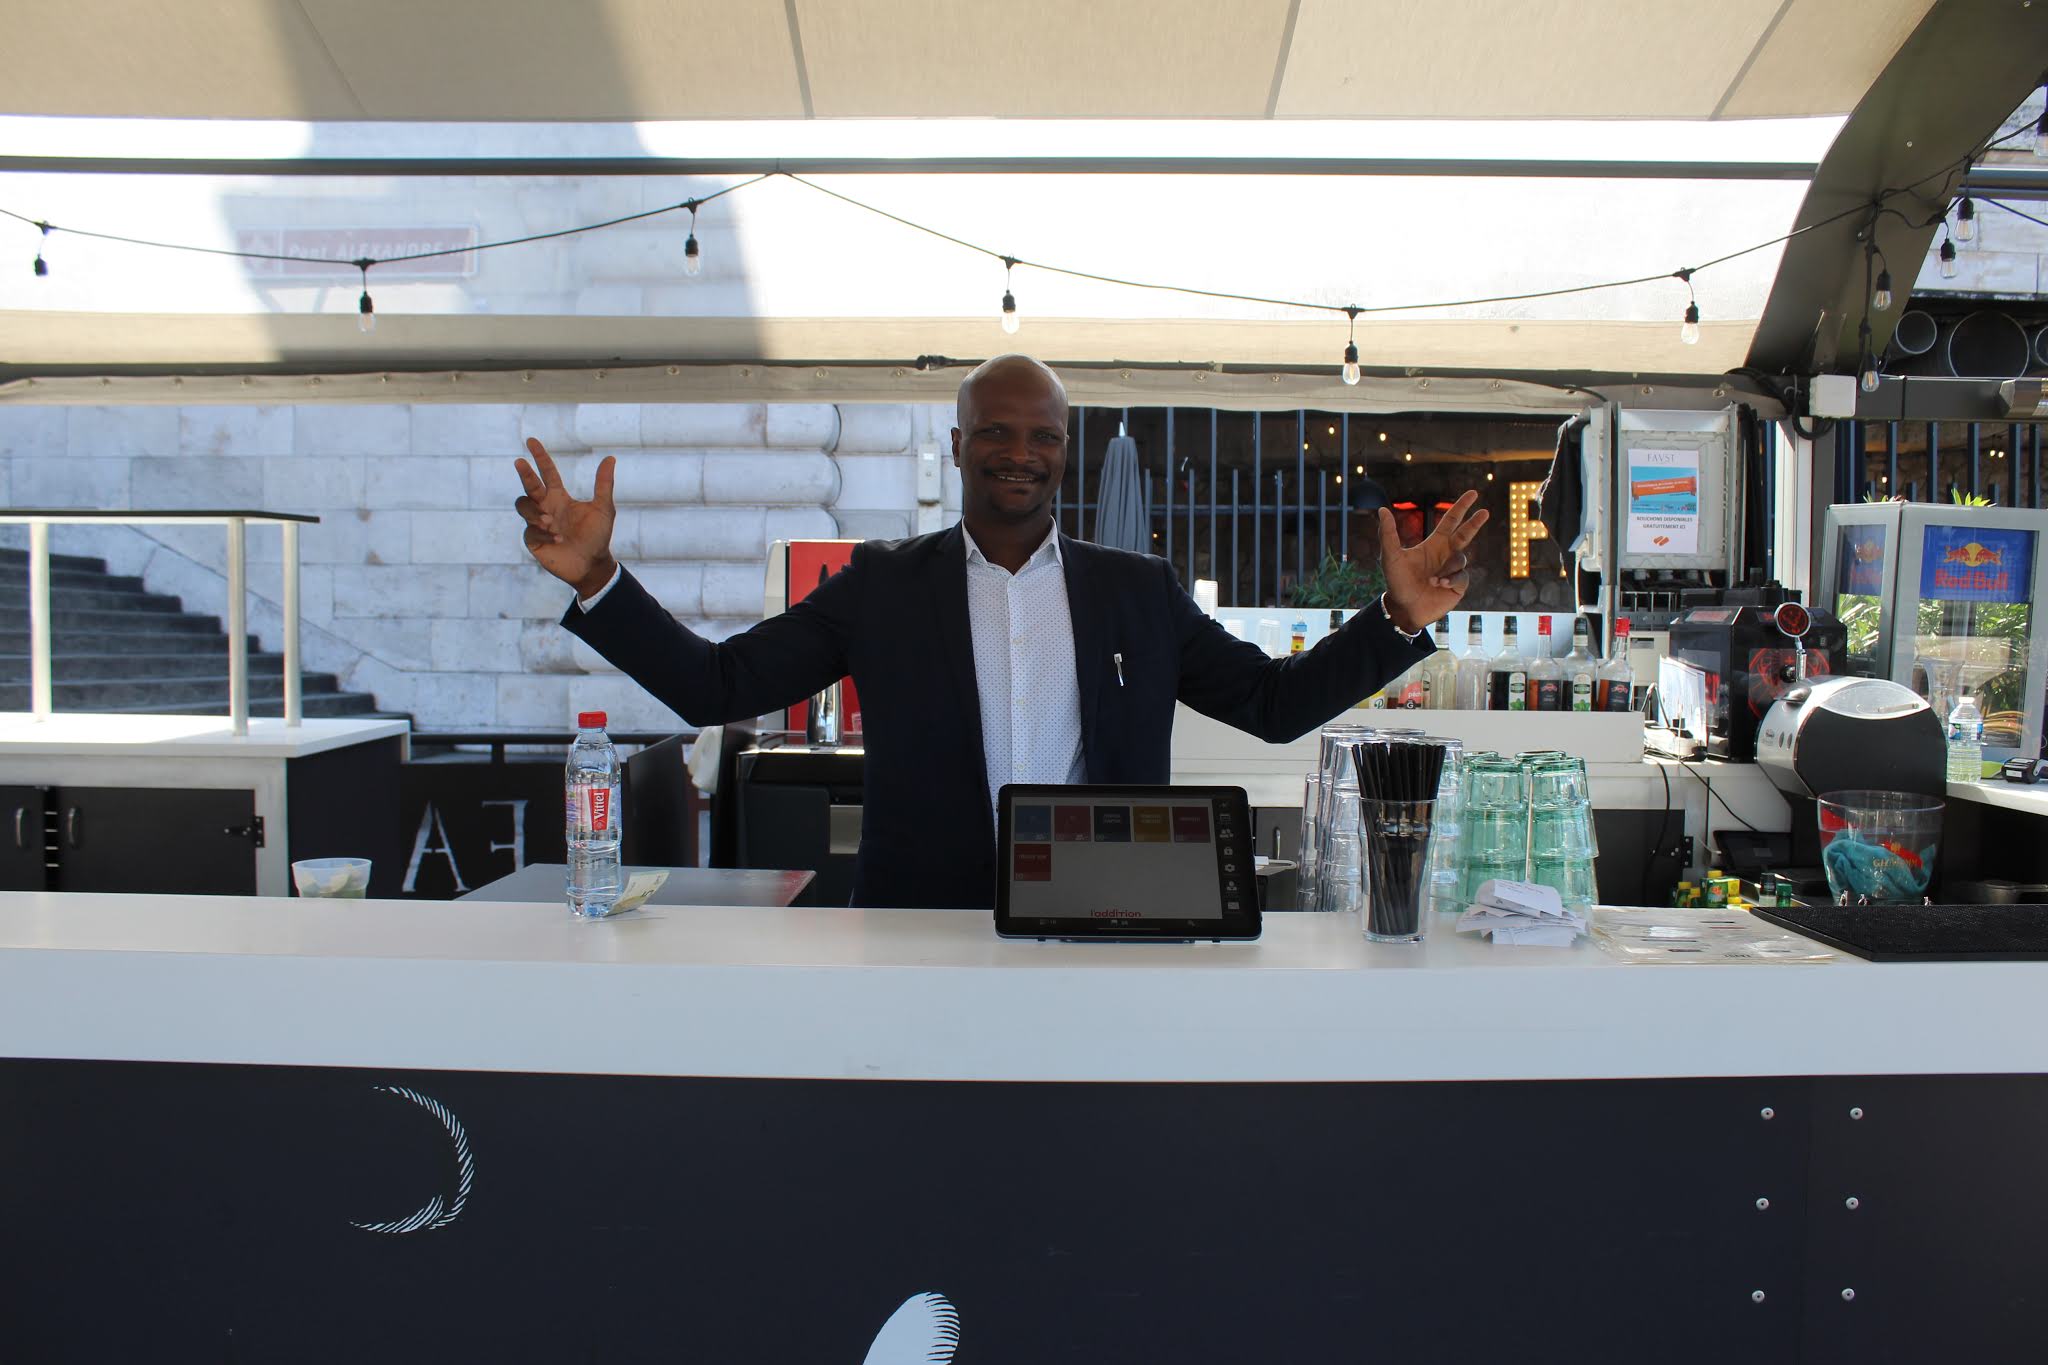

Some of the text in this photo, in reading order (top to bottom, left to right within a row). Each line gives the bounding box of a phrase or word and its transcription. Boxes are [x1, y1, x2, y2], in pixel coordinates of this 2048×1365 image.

[1647, 453, 1675, 463] FAVST
[1934, 569, 2009, 592] Red Bull
[594, 791, 605, 820] Vittel
